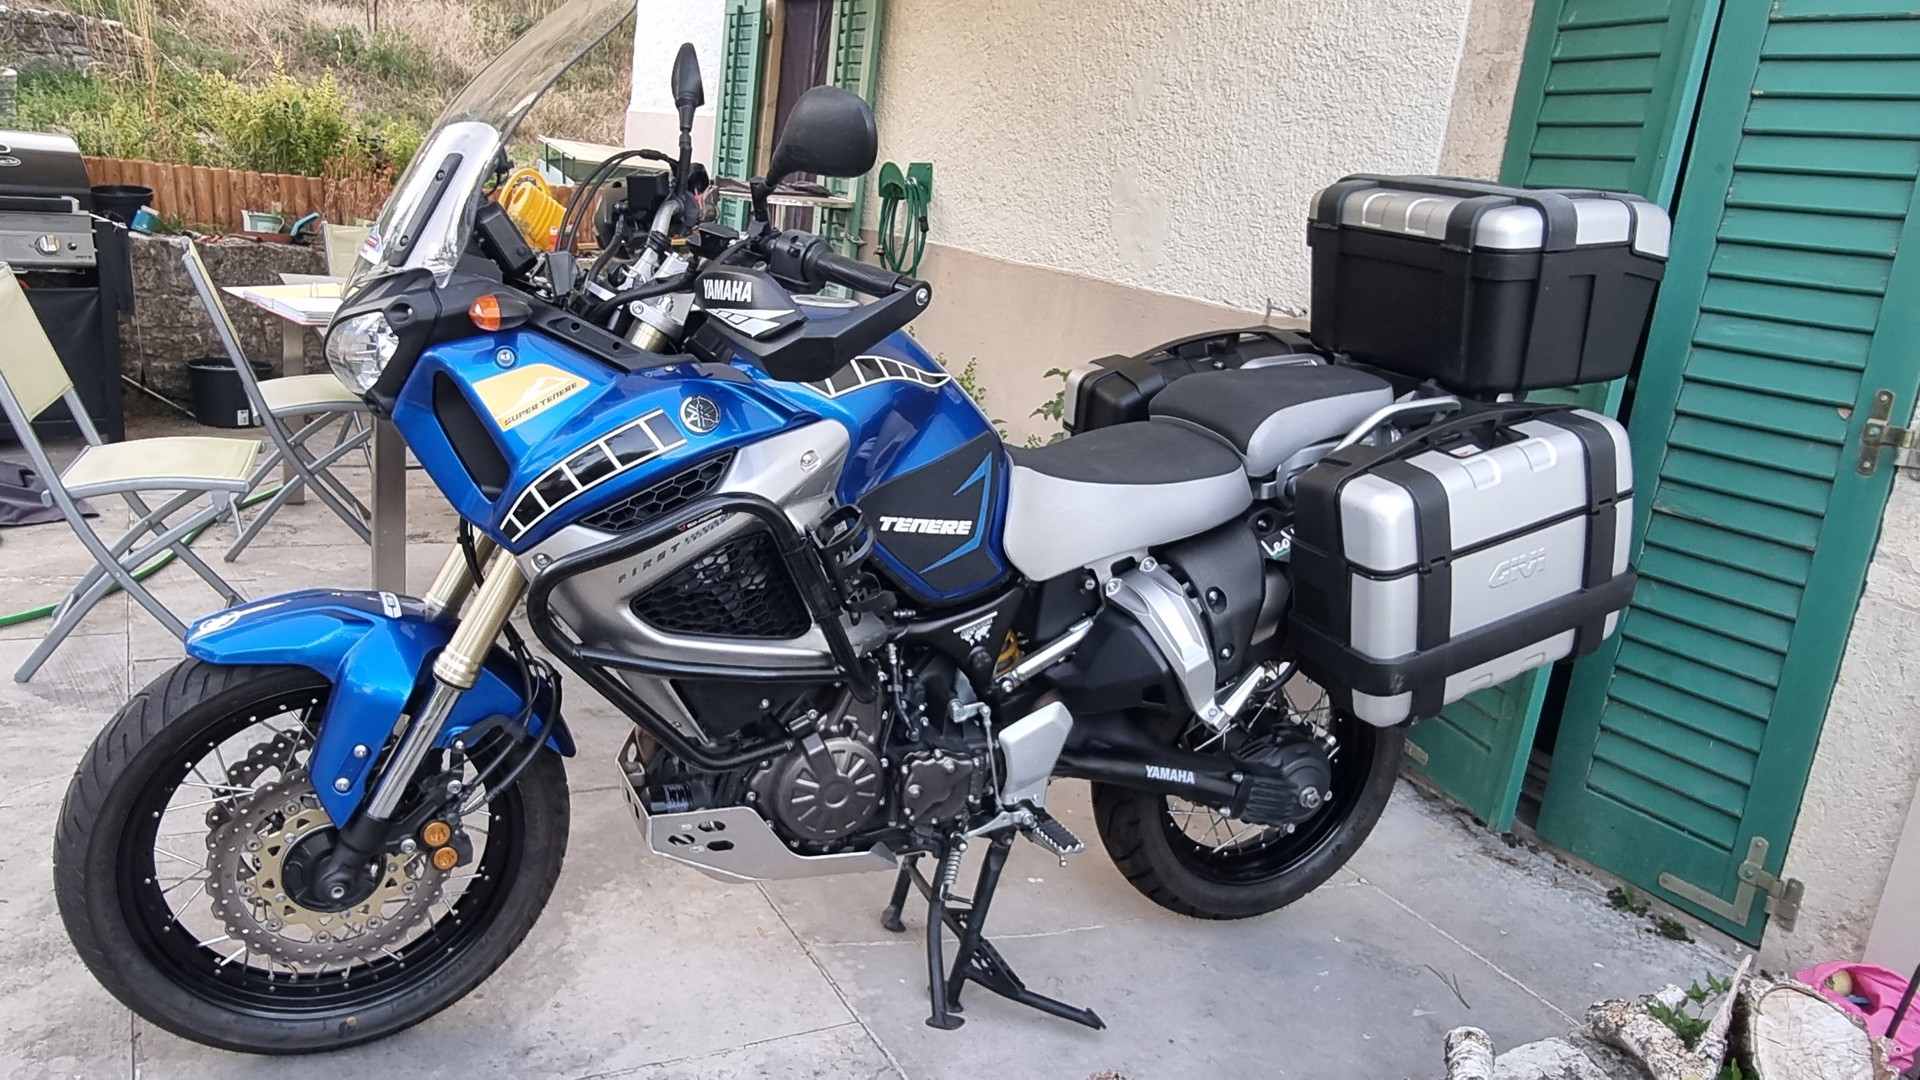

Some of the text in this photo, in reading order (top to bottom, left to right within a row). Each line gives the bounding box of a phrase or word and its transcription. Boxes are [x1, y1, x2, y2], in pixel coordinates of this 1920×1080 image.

[703, 279, 752, 303] YAMAHA
[504, 382, 578, 426] SUPER TENERE
[879, 516, 973, 535] TENERE
[617, 542, 680, 584] FIRST
[1488, 547, 1546, 589] GIVI
[1145, 764, 1196, 785] YAMAHA
